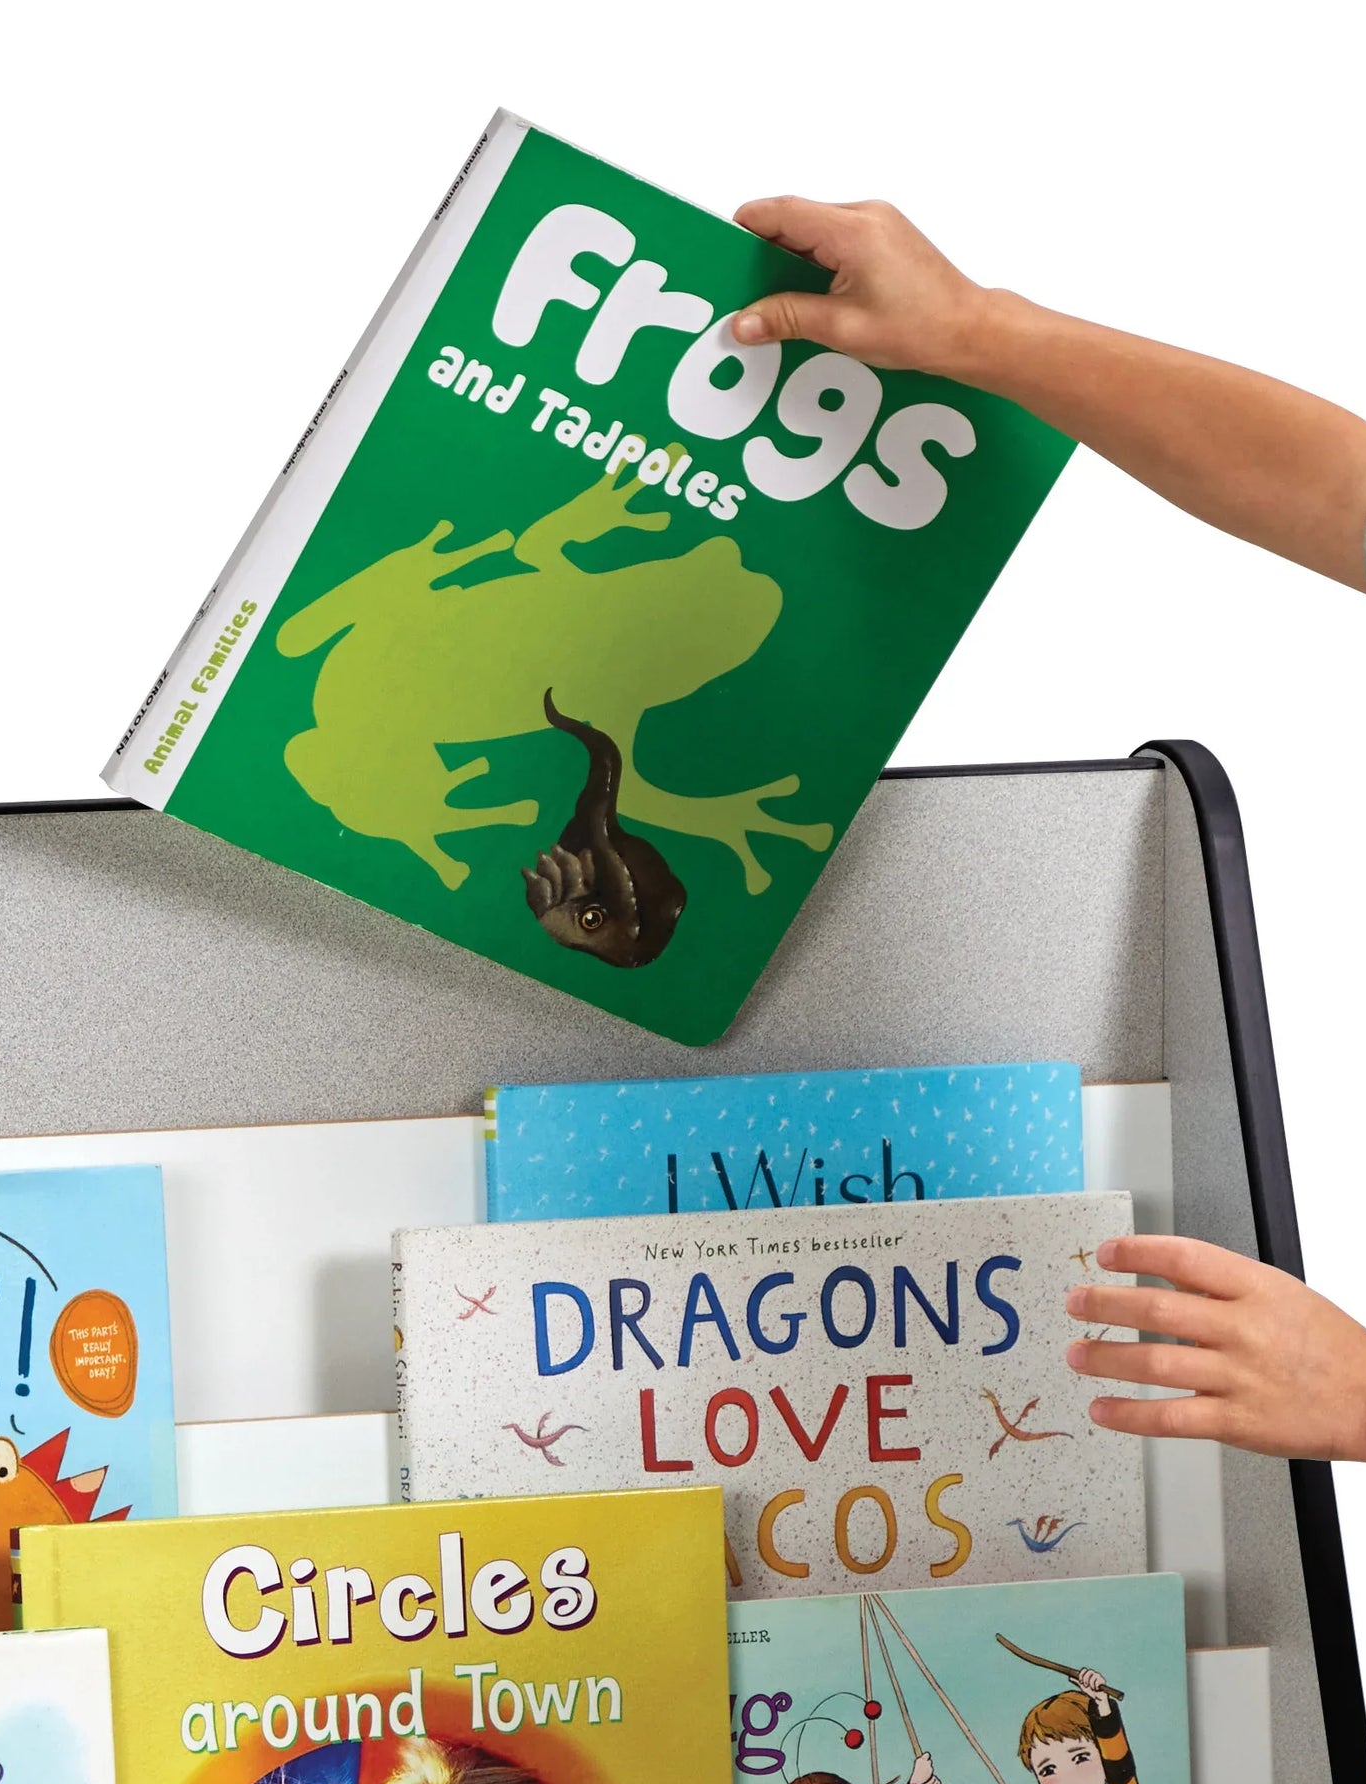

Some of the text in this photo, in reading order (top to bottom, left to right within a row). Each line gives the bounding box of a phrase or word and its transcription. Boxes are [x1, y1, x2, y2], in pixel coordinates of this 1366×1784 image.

[463, 133, 488, 174] Animal
[327, 370, 348, 400] Frogs
[491, 204, 976, 530] Frogs
[313, 402, 327, 425] and
[428, 346, 746, 521] and Tadpoles
[116, 669, 169, 755] ZERO TO TEN
[143, 600, 257, 774] Animal Families
[667, 1138, 925, 1214] I Wish
[694, 1240, 738, 1260] YORK
[811, 1236, 903, 1252] bestseller
[68, 1328, 90, 1341] THIS
[83, 1340, 111, 1354] REALLY
[532, 1256, 1022, 1376] DRAGONS
[89, 1366, 116, 1380] OKAY?
[639, 1374, 921, 1472] LOVE
[201, 1531, 597, 1659] Circles
[181, 1662, 623, 1753] around Town
